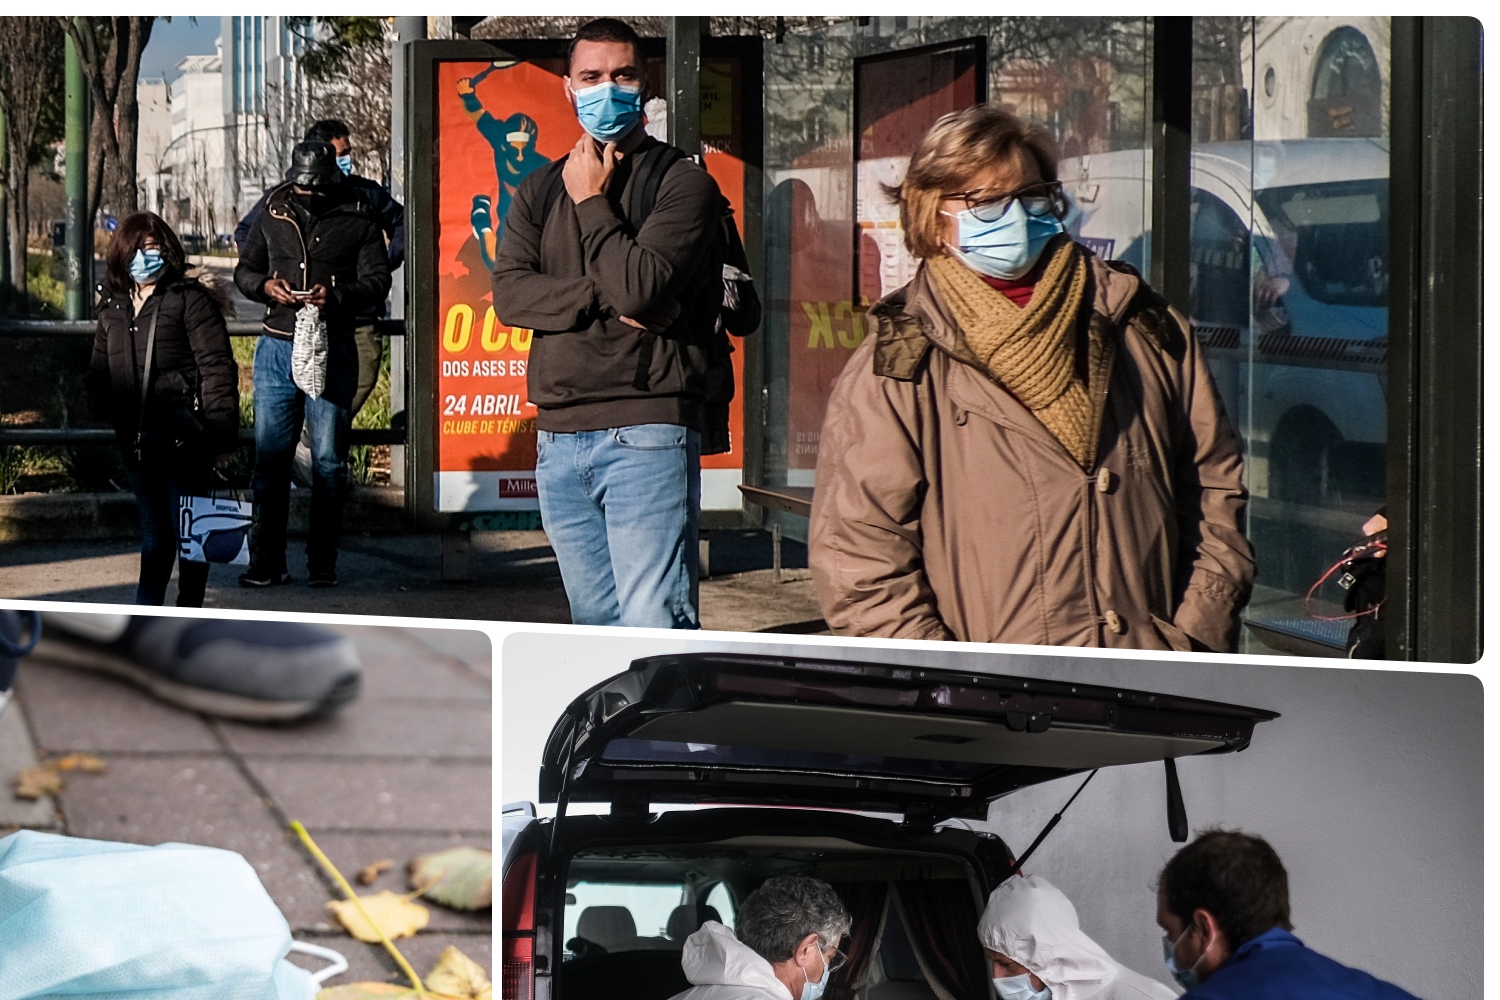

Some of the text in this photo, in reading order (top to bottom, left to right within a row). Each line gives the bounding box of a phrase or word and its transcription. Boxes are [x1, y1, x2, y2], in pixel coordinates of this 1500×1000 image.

[443, 303, 534, 353] O CO
[442, 360, 528, 377] DOS ASES ES
[443, 394, 467, 416] 24
[470, 394, 521, 415] ABRIL
[443, 417, 537, 434] CLUBE DE TÉNIS E
[507, 479, 537, 492] Mille
